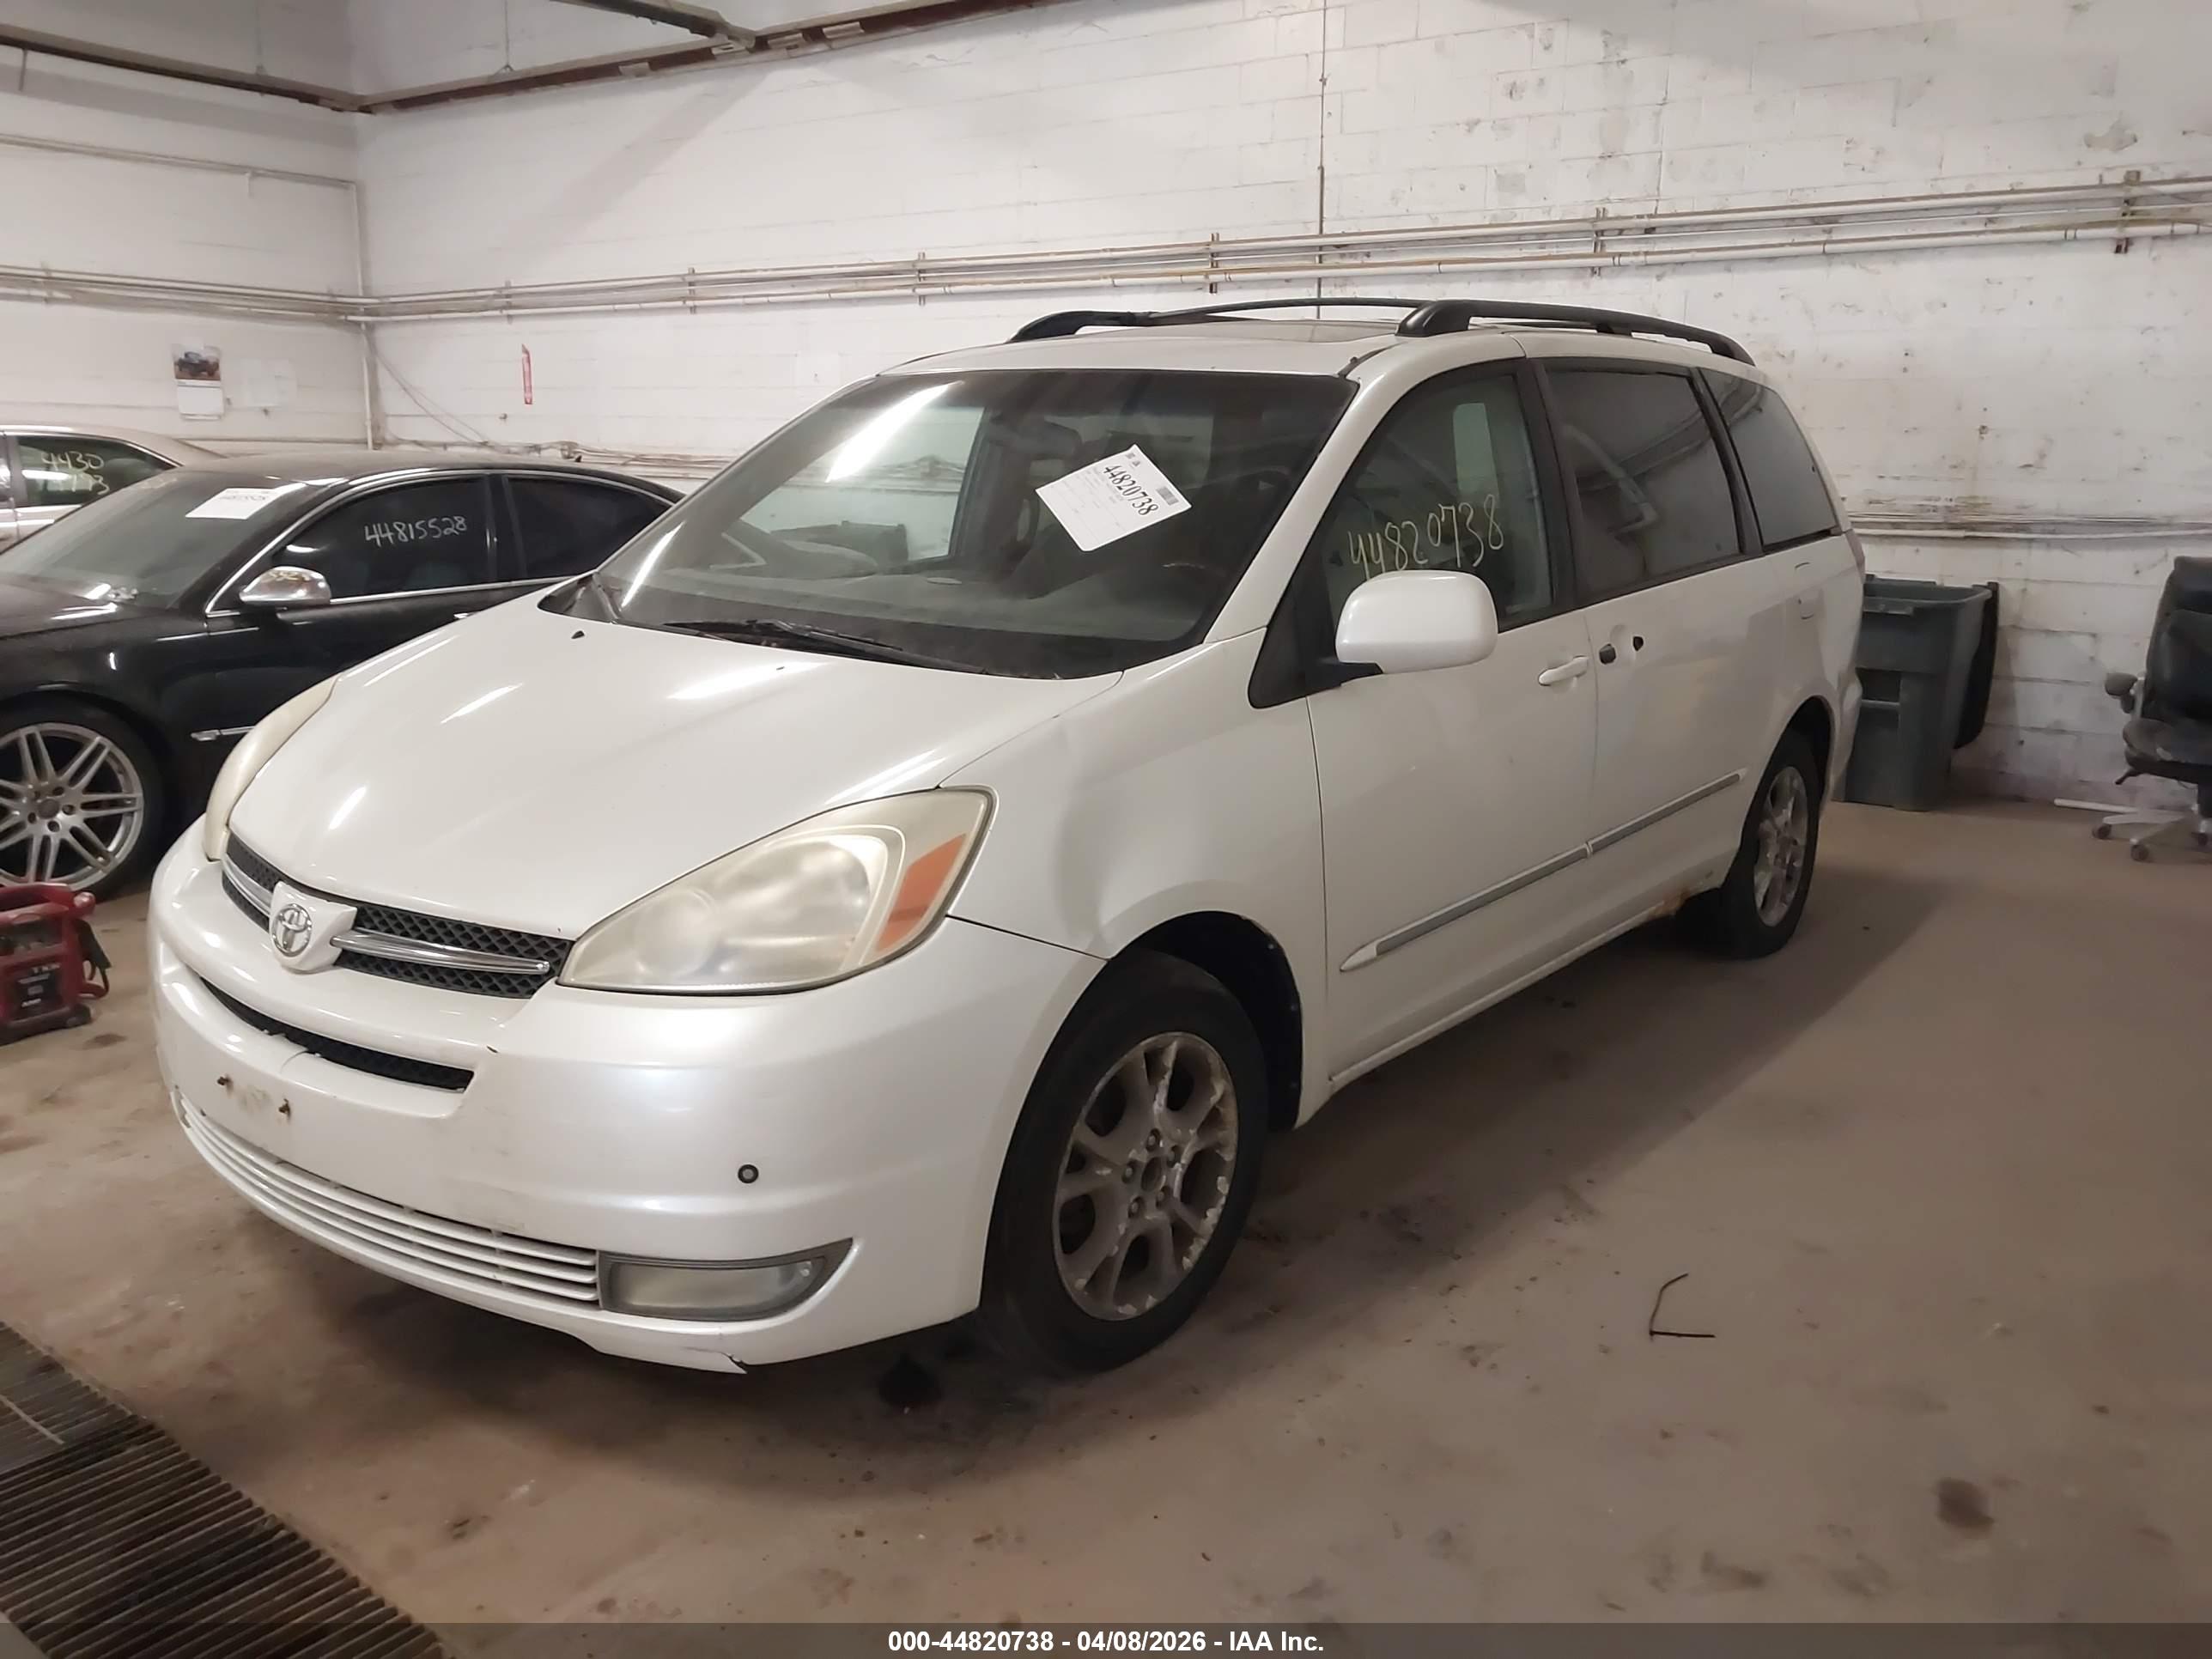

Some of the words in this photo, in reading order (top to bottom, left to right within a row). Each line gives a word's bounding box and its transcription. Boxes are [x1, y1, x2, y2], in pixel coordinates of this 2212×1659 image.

[1103, 465, 1159, 516] 44820738
[364, 515, 468, 547] 44815528
[1347, 494, 1504, 580] 44820738
